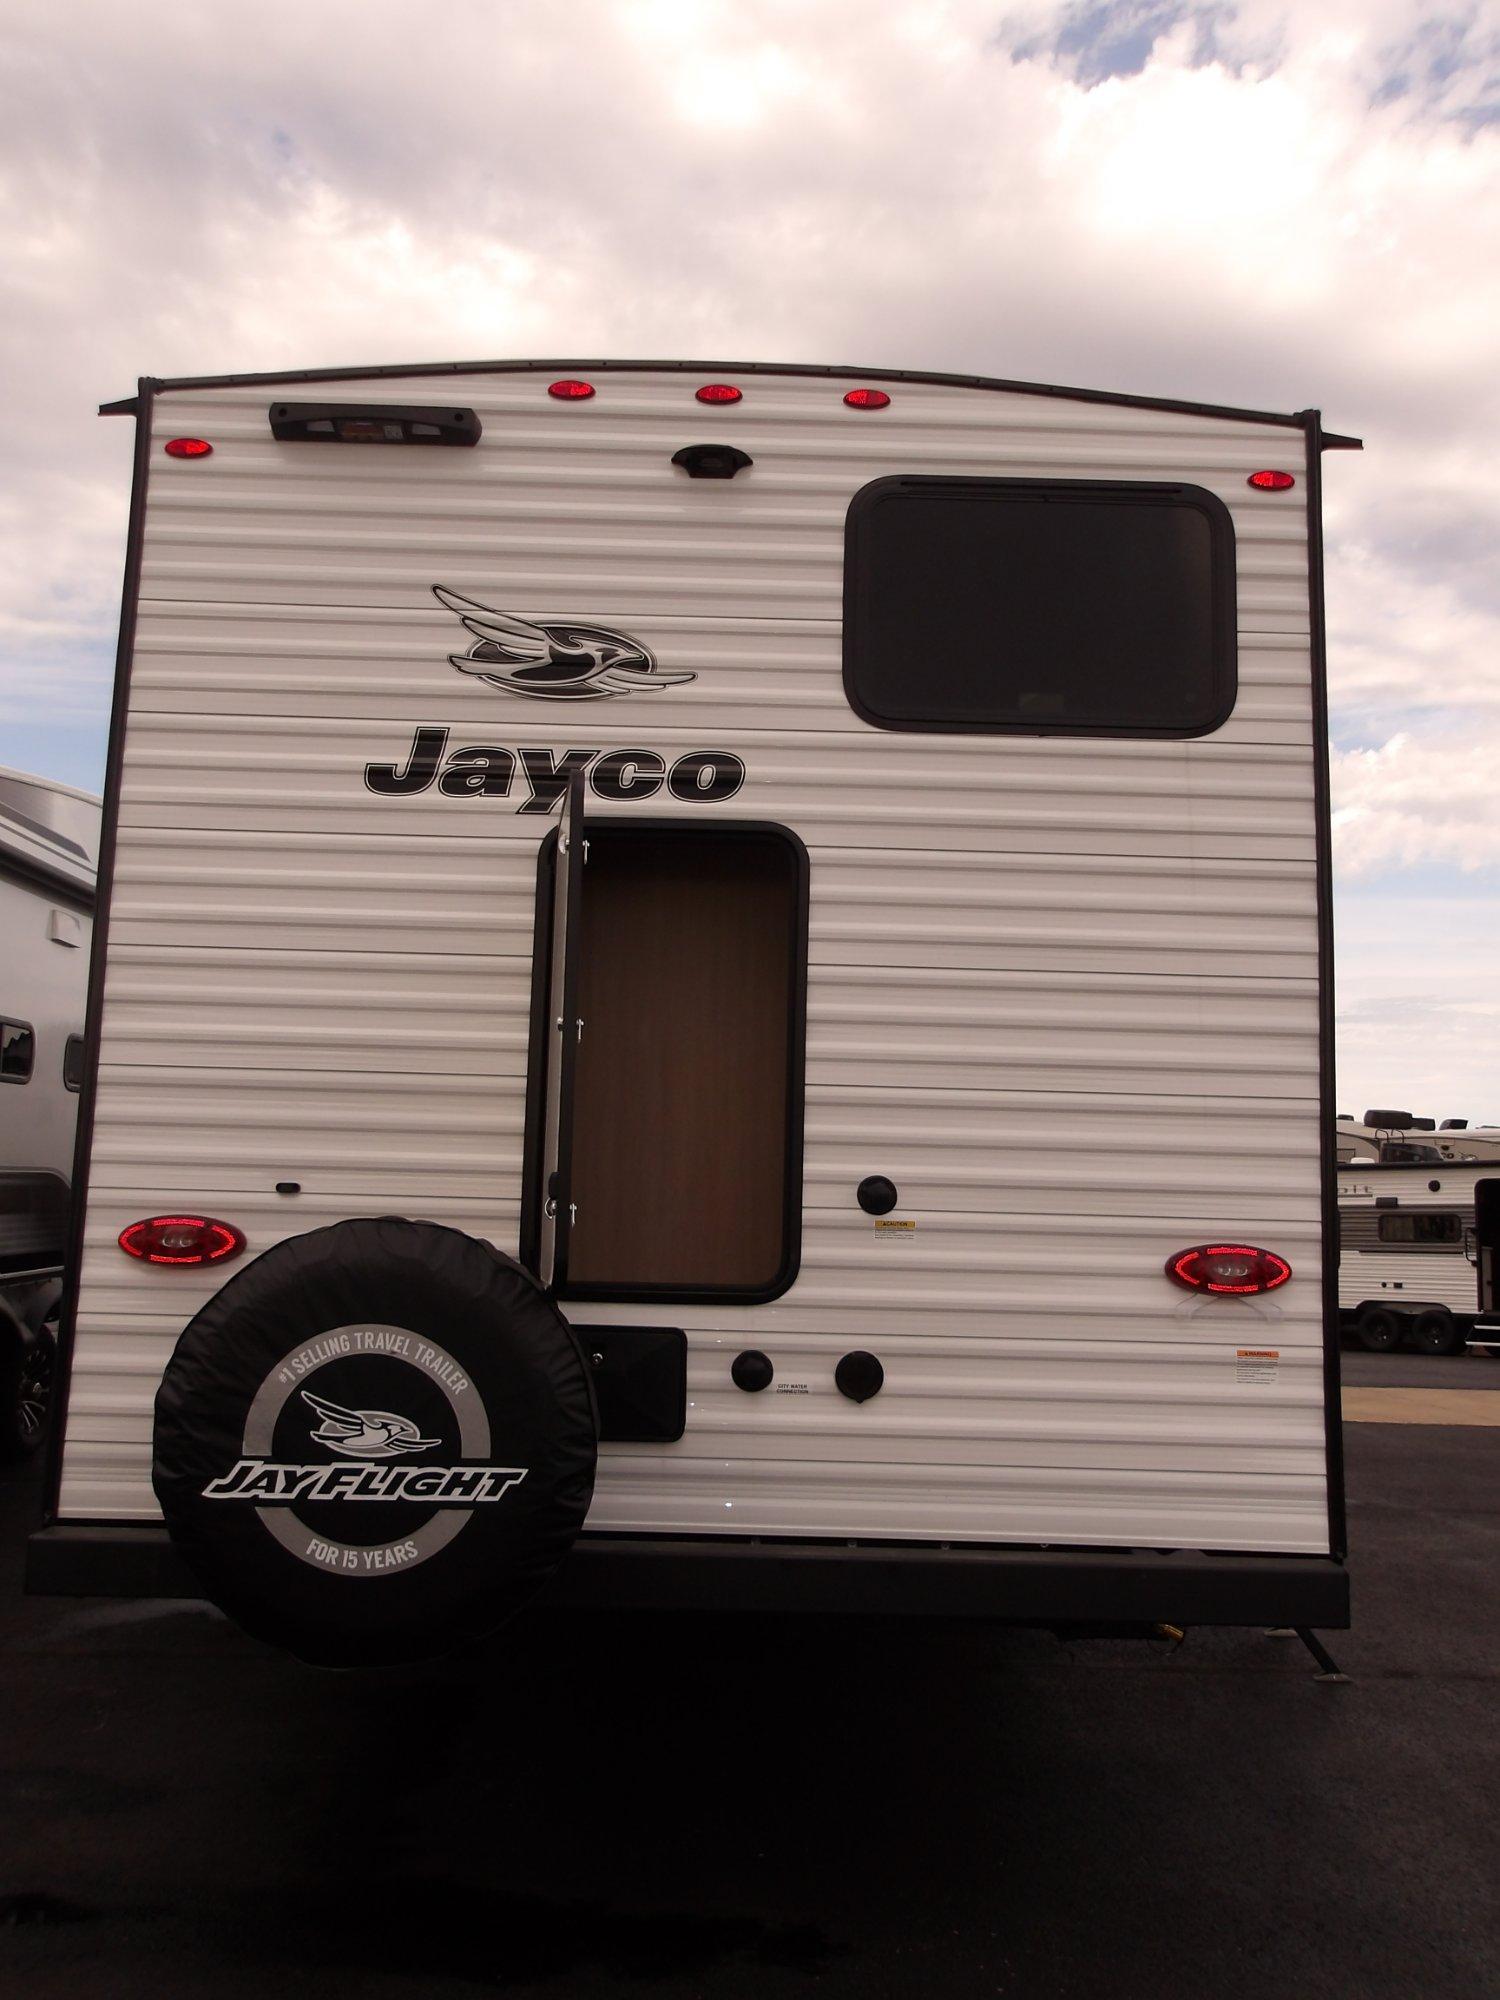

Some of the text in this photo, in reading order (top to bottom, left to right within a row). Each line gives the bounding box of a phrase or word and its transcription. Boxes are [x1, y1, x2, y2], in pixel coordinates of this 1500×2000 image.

[364, 726, 746, 815] Jayco
[278, 1331, 469, 1395] #1 SELLING TRAVEL TRAILER
[306, 1538, 419, 1569] FOR 15 YEARS
